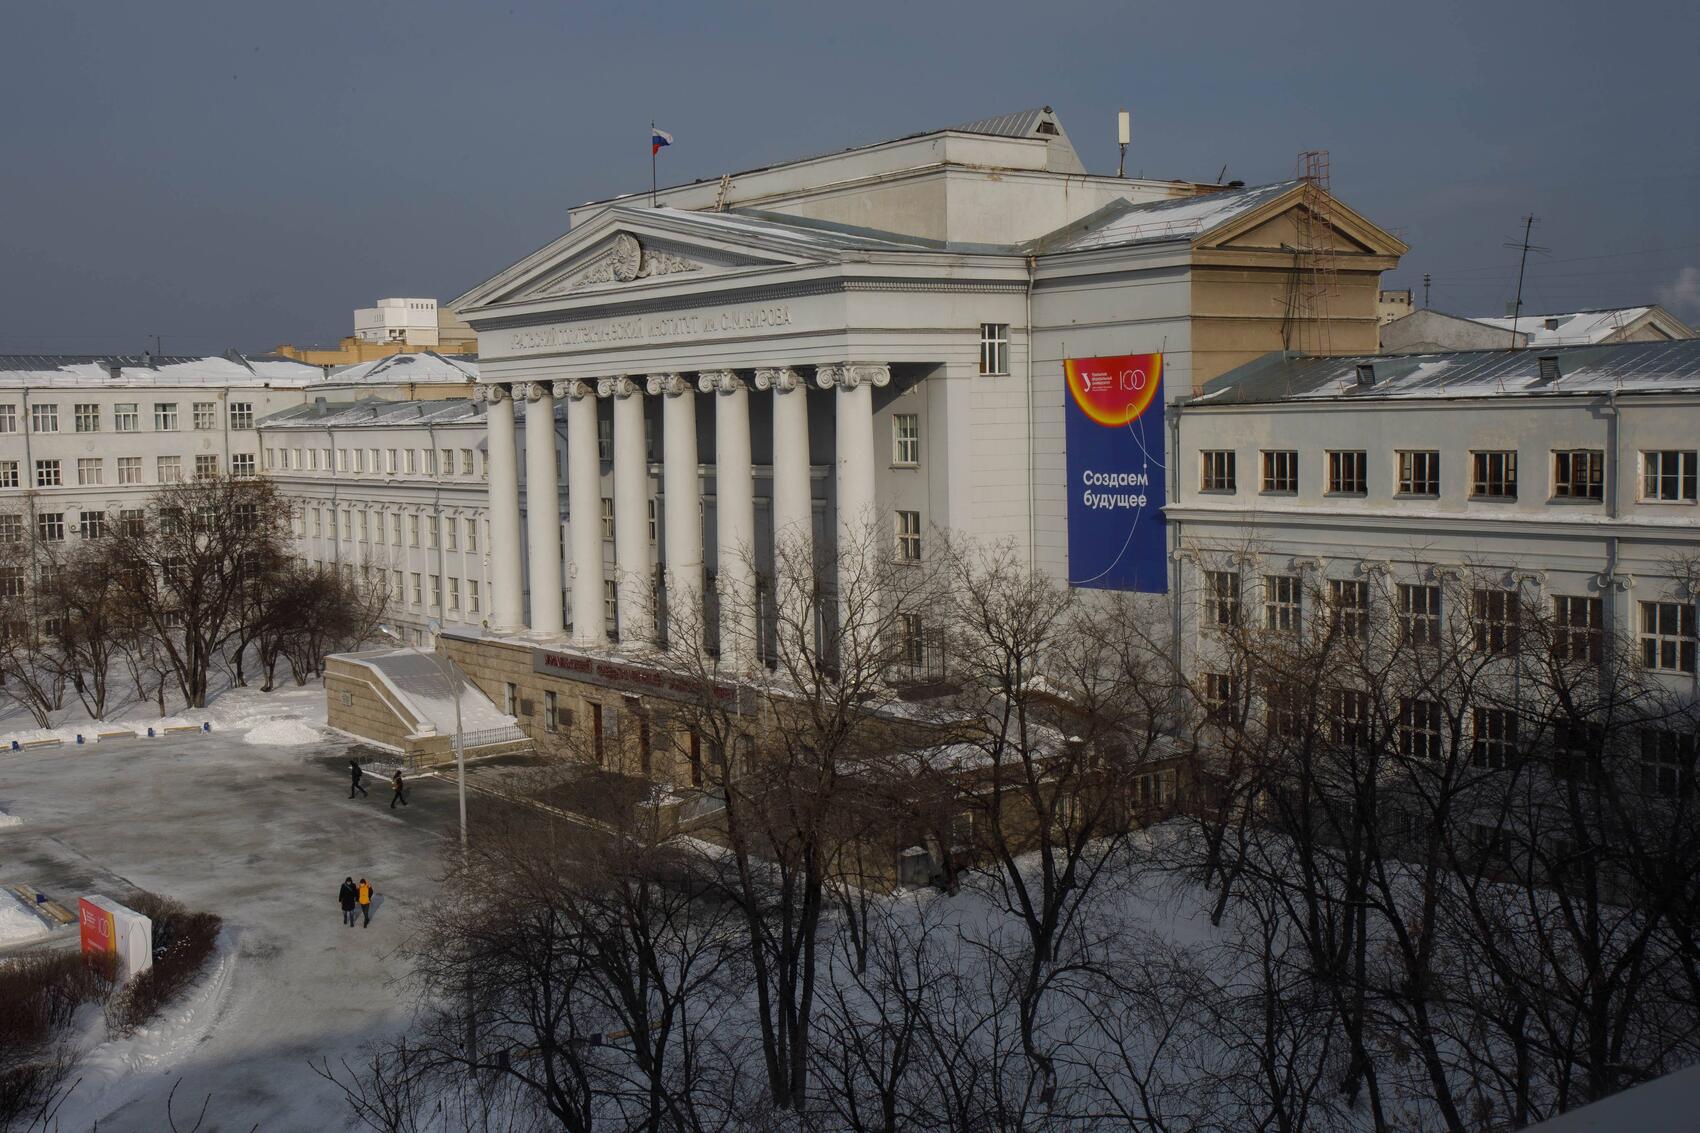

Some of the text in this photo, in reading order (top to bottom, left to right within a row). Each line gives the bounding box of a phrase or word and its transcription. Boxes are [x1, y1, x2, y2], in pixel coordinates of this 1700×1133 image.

[1119, 369, 1146, 391] 100
[1083, 470, 1149, 488] Создаем
[1083, 489, 1147, 510] будущее
